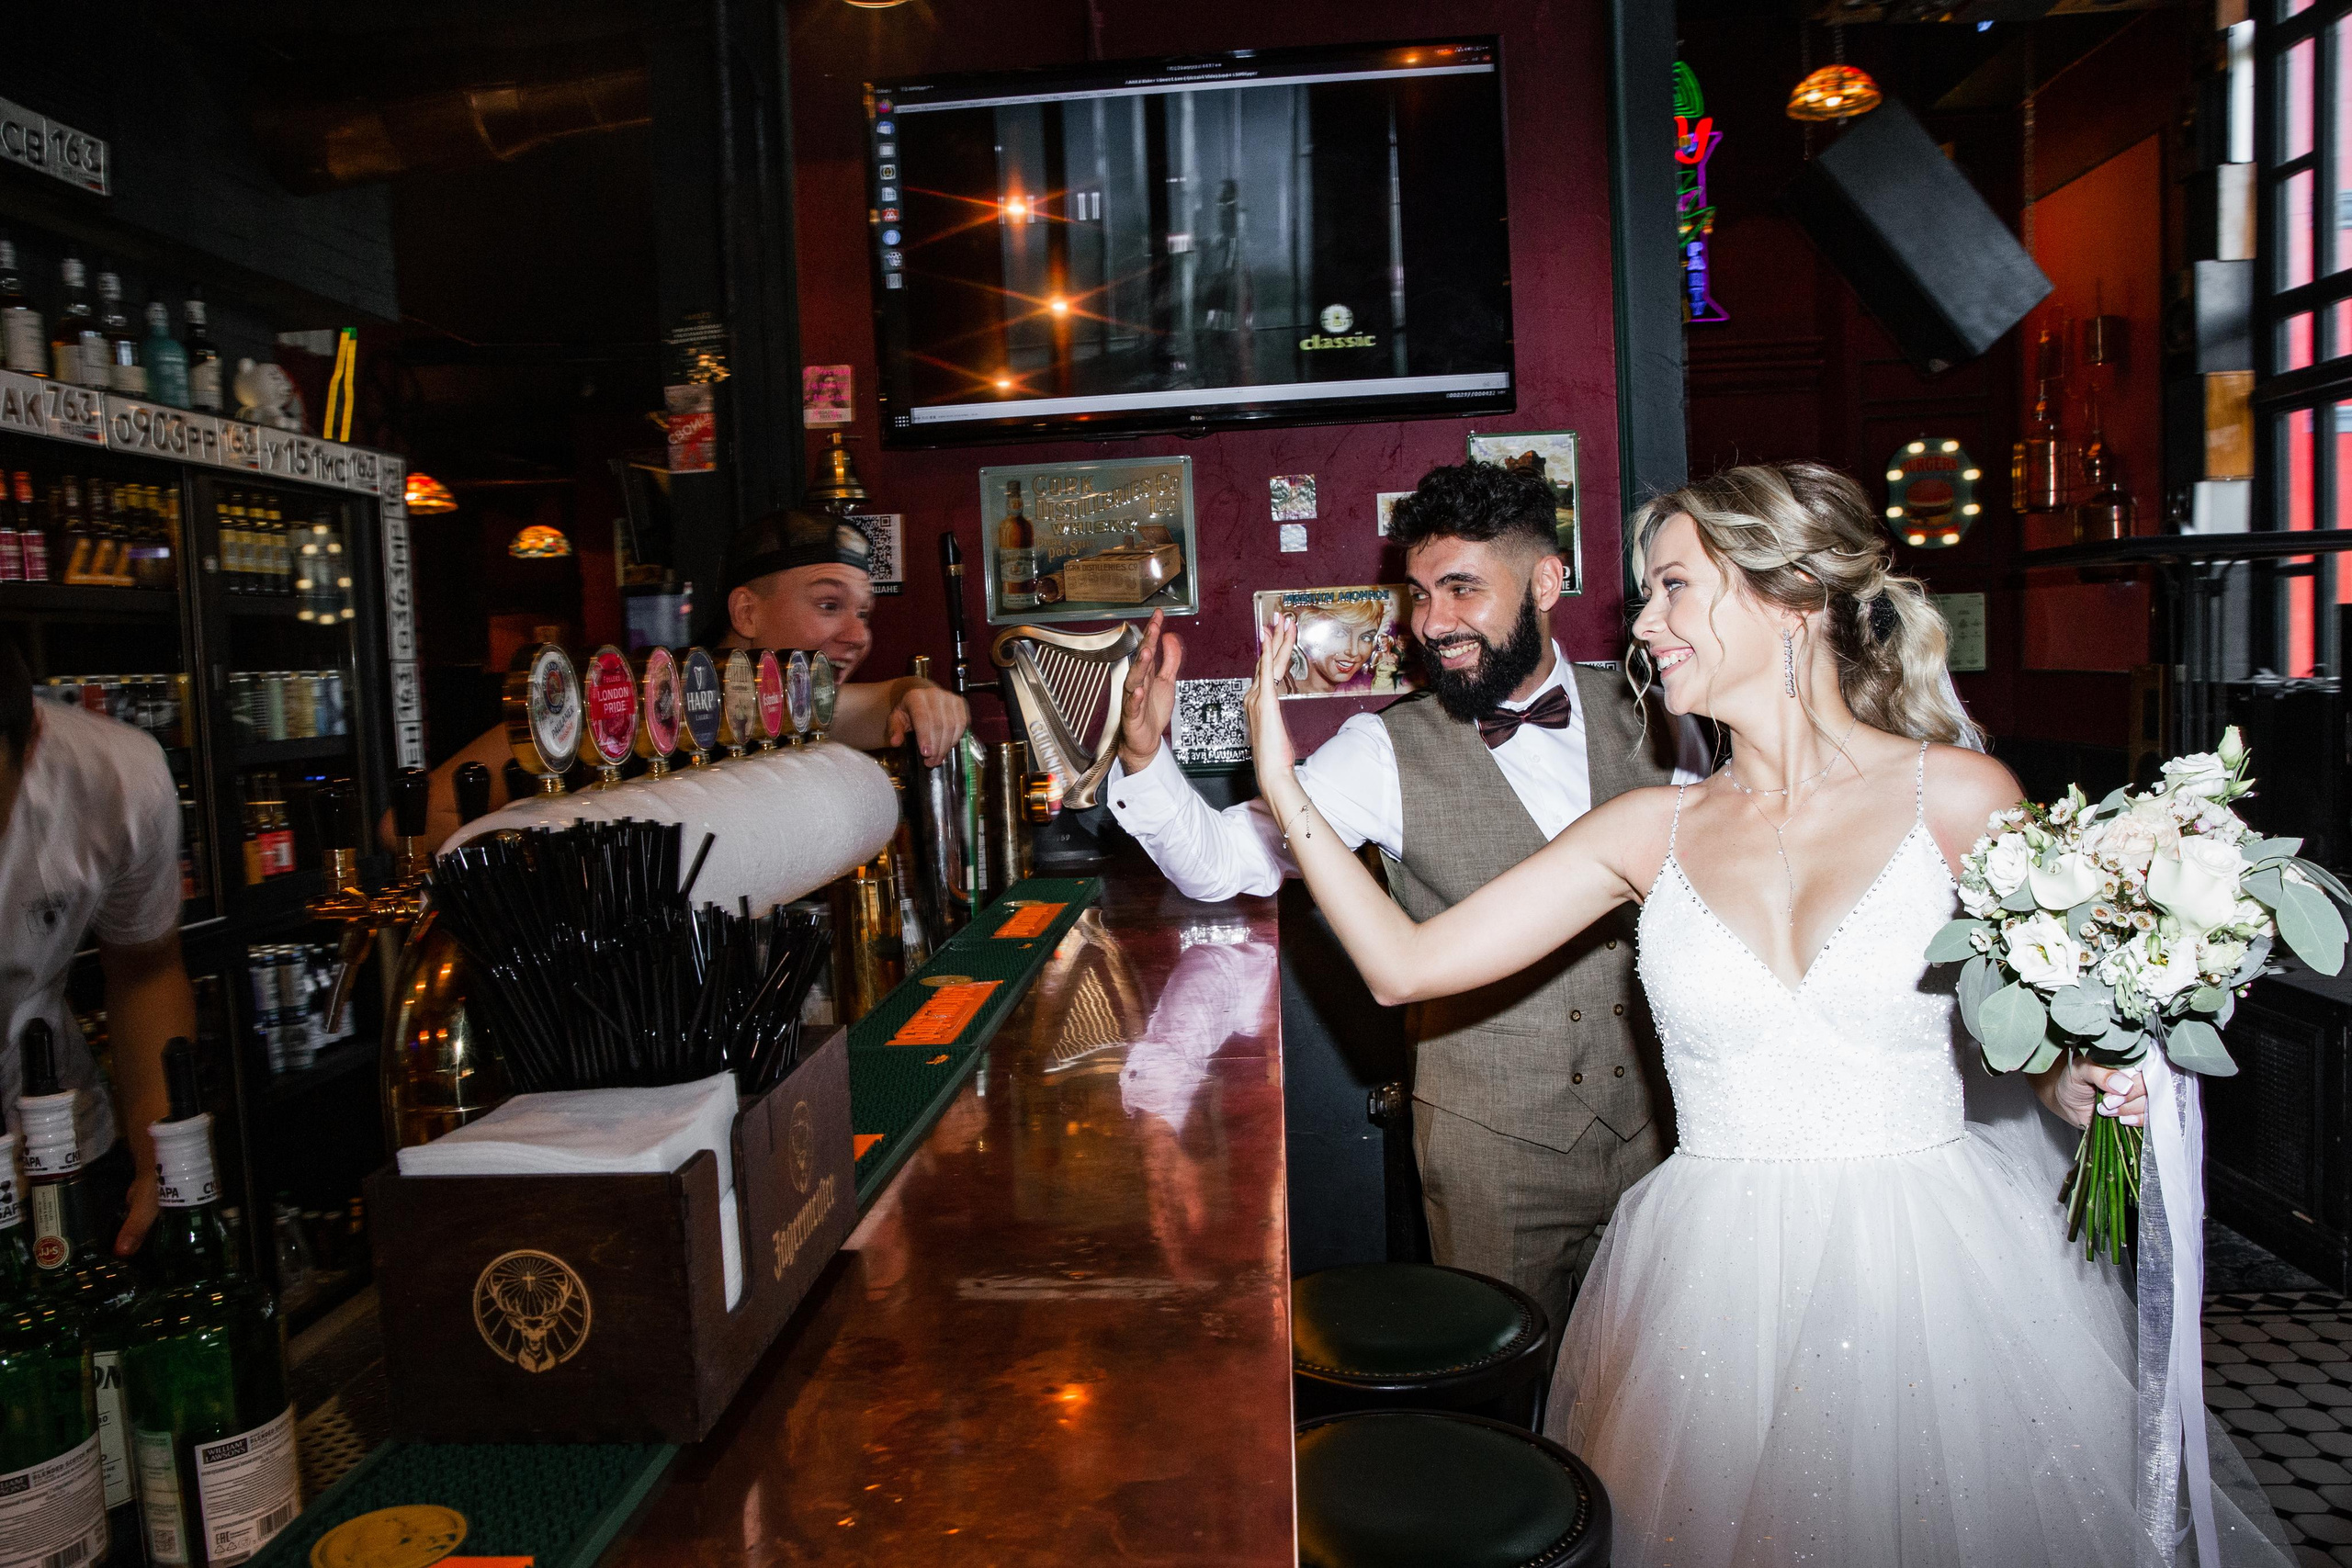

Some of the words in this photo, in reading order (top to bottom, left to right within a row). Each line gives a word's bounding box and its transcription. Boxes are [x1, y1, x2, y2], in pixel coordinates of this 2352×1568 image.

[1299, 332, 1376, 351] classic
[1032, 475, 1095, 499] CORK
[1035, 477, 1153, 522] DISTILLERIES
[1051, 518, 1138, 536] WHISKY
[1082, 563, 1126, 571] DISTILLERIES
[872, 585, 899, 593] ШАНЕ
[1283, 591, 1335, 605] MARILYN
[1338, 589, 1390, 604] MONROE
[597, 686, 629, 702] LONDON
[686, 689, 714, 712] HARP
[604, 700, 627, 715] PRIDE
[551, 705, 575, 739] PAULANER
[1029, 720, 1068, 788] GUINN
[205, 1447, 245, 1462] LAWSON'S
[207, 1440, 243, 1456] WILLIAM
[33, 1464, 64, 1480] BLENDED
